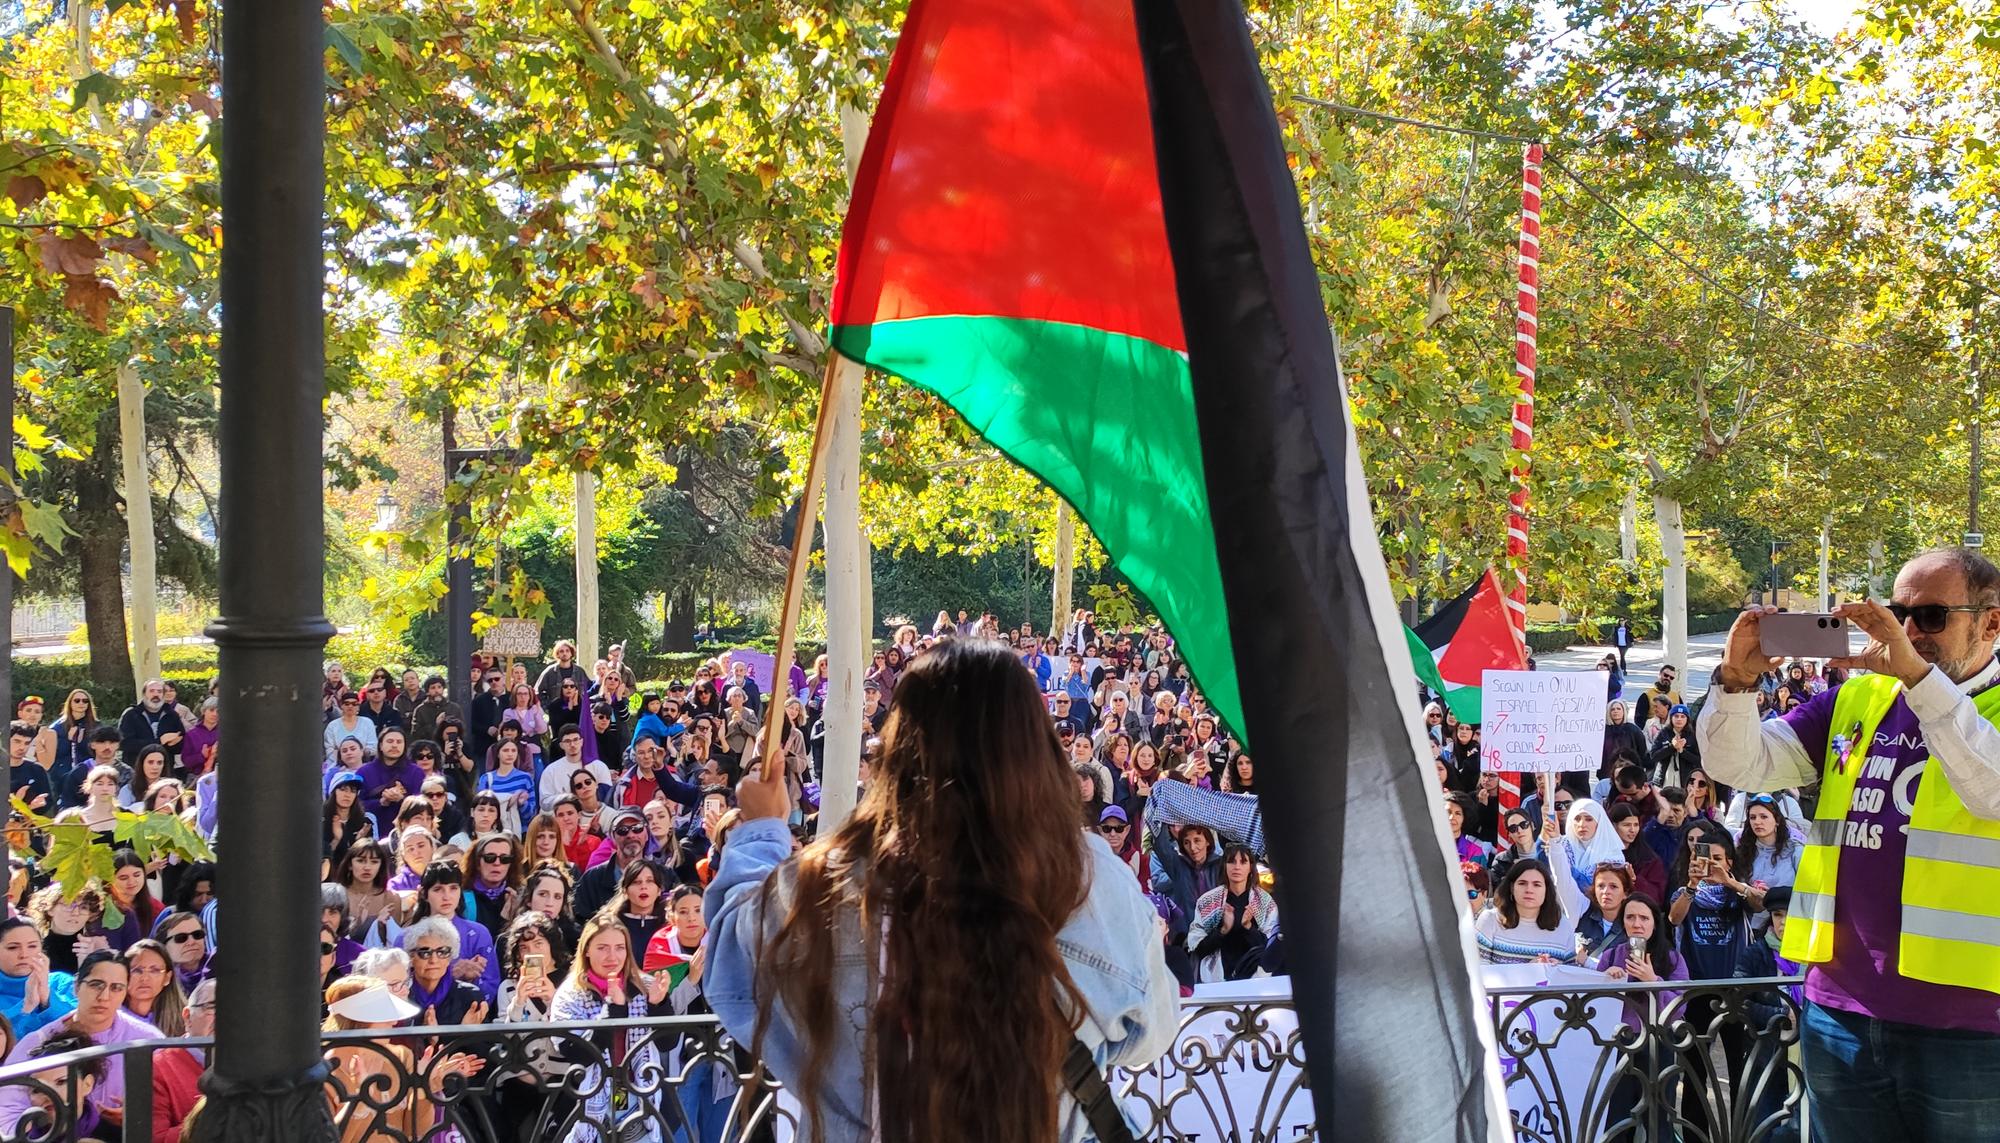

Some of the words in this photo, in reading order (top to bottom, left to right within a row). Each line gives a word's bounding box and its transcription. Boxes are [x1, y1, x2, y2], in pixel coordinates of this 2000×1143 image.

[1529, 680, 1545, 693] LA
[1549, 676, 1577, 693] ONU
[1496, 699, 1544, 713] ISRAEL
[1551, 695, 1597, 713] ASESINA
[1493, 714, 1508, 735] 7
[1506, 723, 1549, 733] MUJERES
[1535, 735, 1549, 754] 2
[1482, 742, 1503, 771] 48
